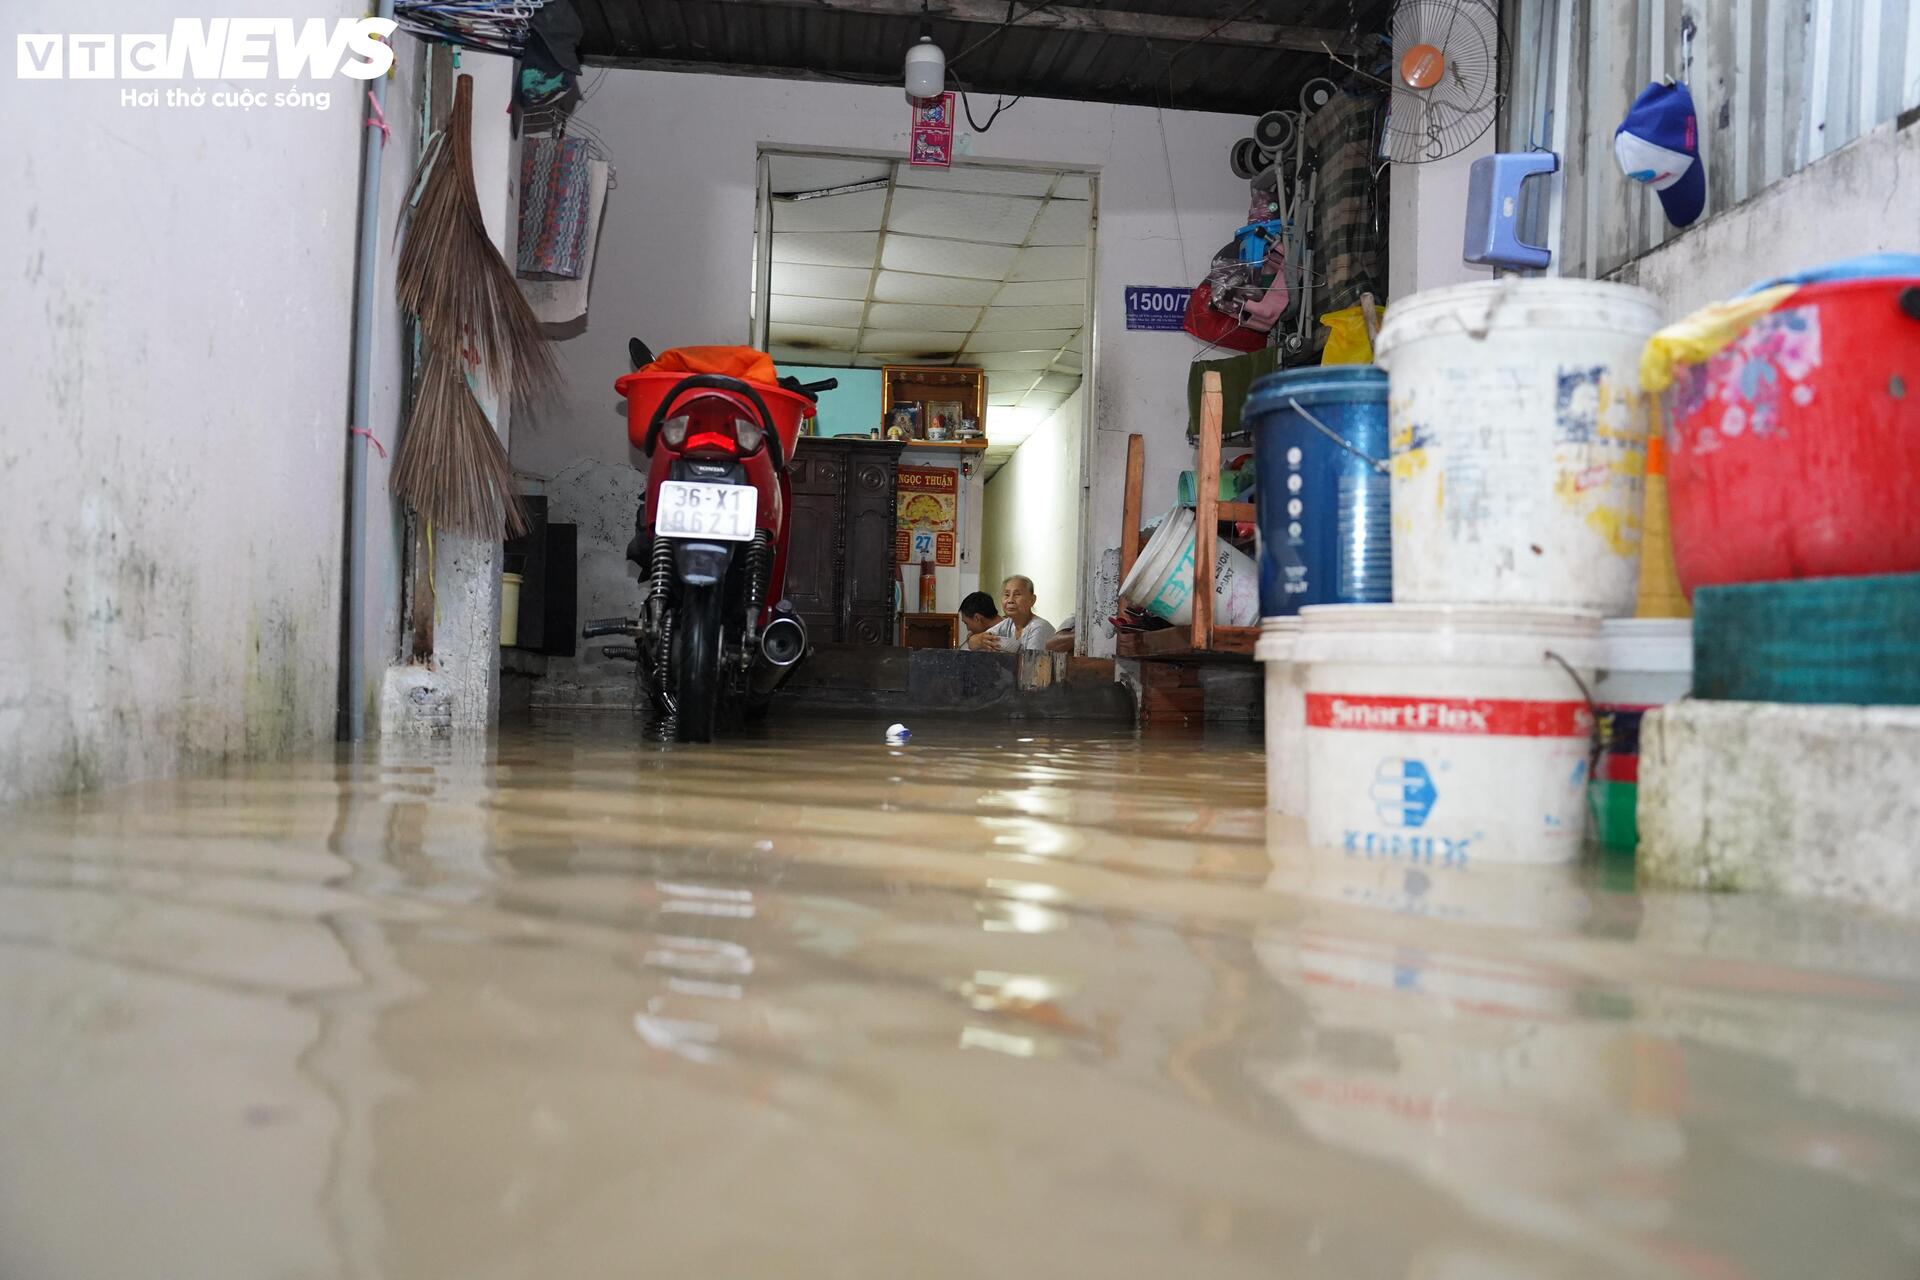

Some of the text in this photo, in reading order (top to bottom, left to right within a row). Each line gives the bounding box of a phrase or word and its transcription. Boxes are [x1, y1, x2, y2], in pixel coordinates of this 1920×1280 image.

[1129, 292, 1191, 312] 1500/7
[898, 473, 953, 488] NGỌC THUẬN
[915, 535, 932, 550] 27
[1330, 698, 1486, 730] SmartFlex
